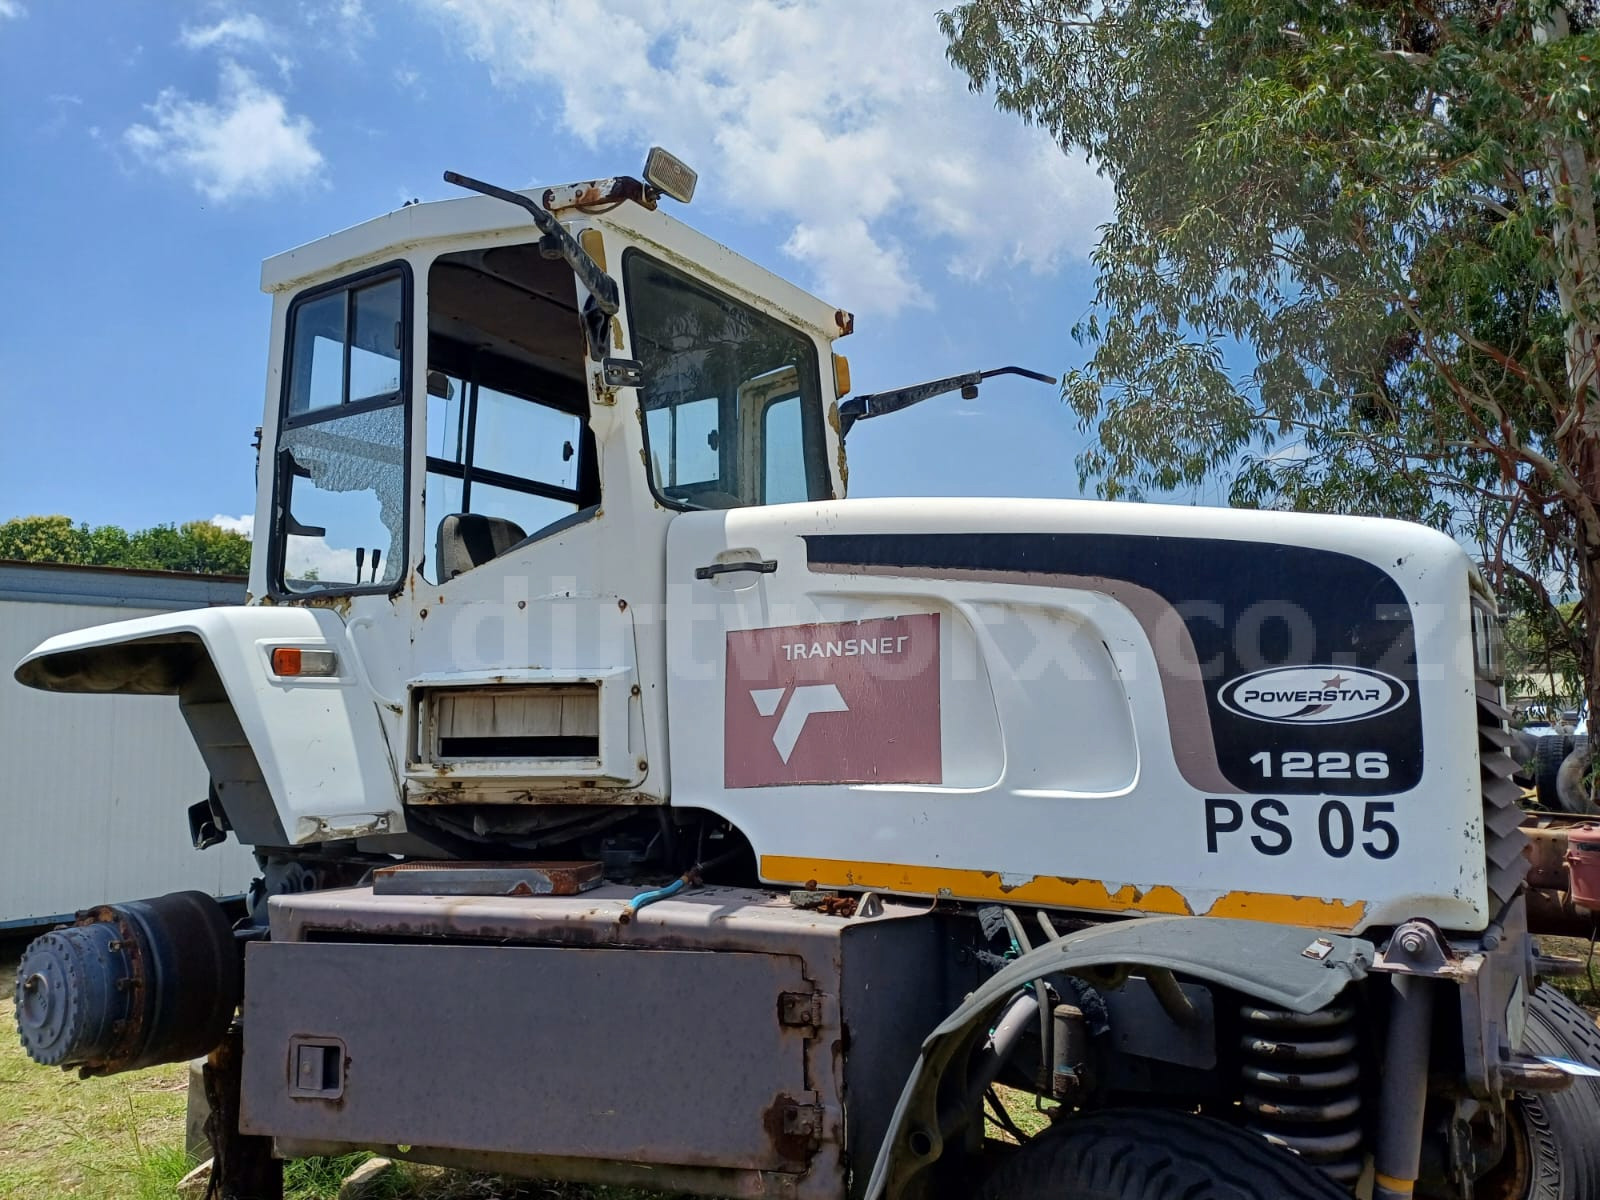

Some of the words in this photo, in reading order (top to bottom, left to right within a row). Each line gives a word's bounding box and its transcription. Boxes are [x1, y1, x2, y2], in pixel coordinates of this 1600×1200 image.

[782, 636, 909, 660] TRANSNET
[1244, 689, 1380, 703] POWERSTAR
[1249, 752, 1390, 779] 1226
[1205, 799, 1293, 856] PS
[1318, 800, 1400, 860] 05
